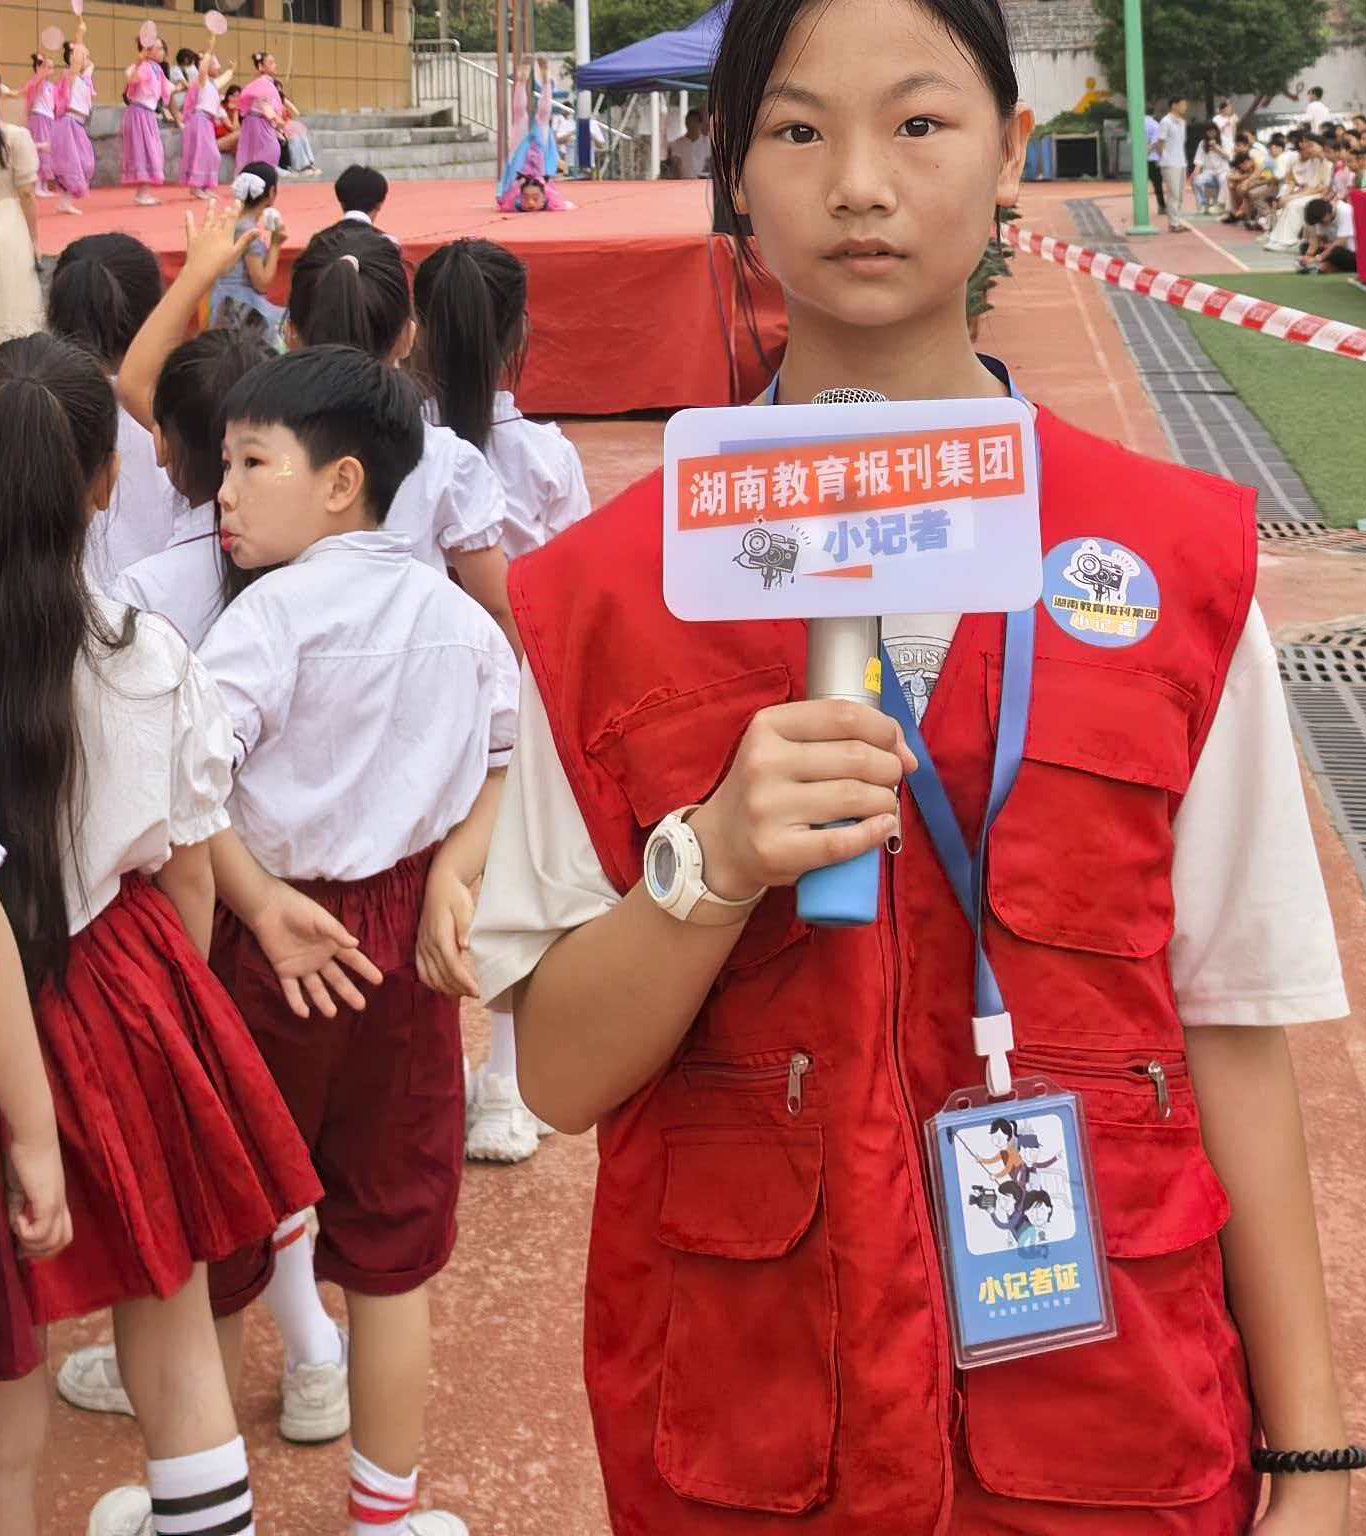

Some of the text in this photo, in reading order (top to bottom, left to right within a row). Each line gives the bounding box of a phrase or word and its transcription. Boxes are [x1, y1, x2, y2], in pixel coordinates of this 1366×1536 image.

[688, 434, 1016, 518] 湖南教育报刊集团
[822, 508, 952, 563] 小记者
[978, 1262, 1081, 1305] 小记者证
